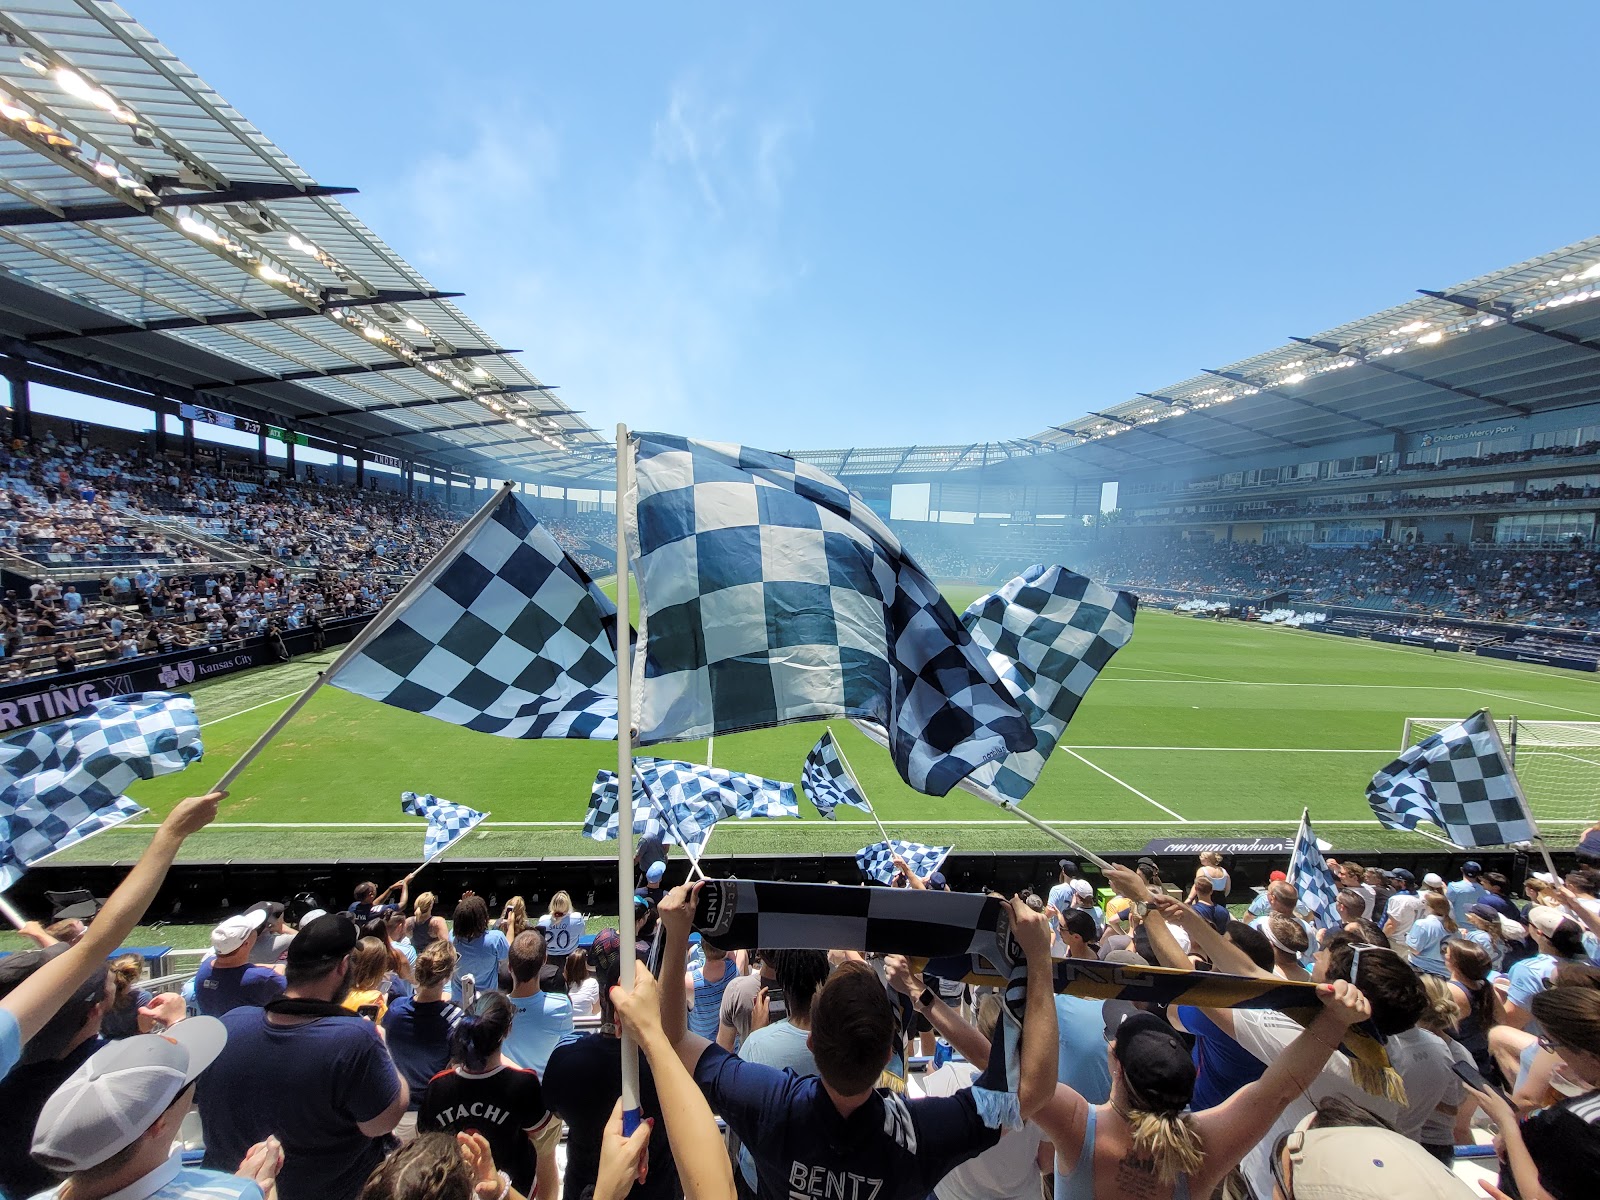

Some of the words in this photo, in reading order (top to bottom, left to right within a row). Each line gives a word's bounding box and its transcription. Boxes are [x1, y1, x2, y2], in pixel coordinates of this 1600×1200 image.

[244, 421, 260, 433] 7:37
[270, 430, 282, 438] ATX
[1433, 432, 1468, 442] Children's
[1469, 429, 1494, 437] Mercy
[1496, 426, 1516, 434] Park
[374, 454, 402, 469] ANDREU
[198, 660, 234, 674] Kansas
[234, 655, 252, 666] City
[104, 675, 134, 698] XI
[722, 892, 736, 928] CITY
[545, 930, 570, 950] 20
[436, 1102, 510, 1128] ITACHI
[788, 1160, 884, 1200] BENTZ
